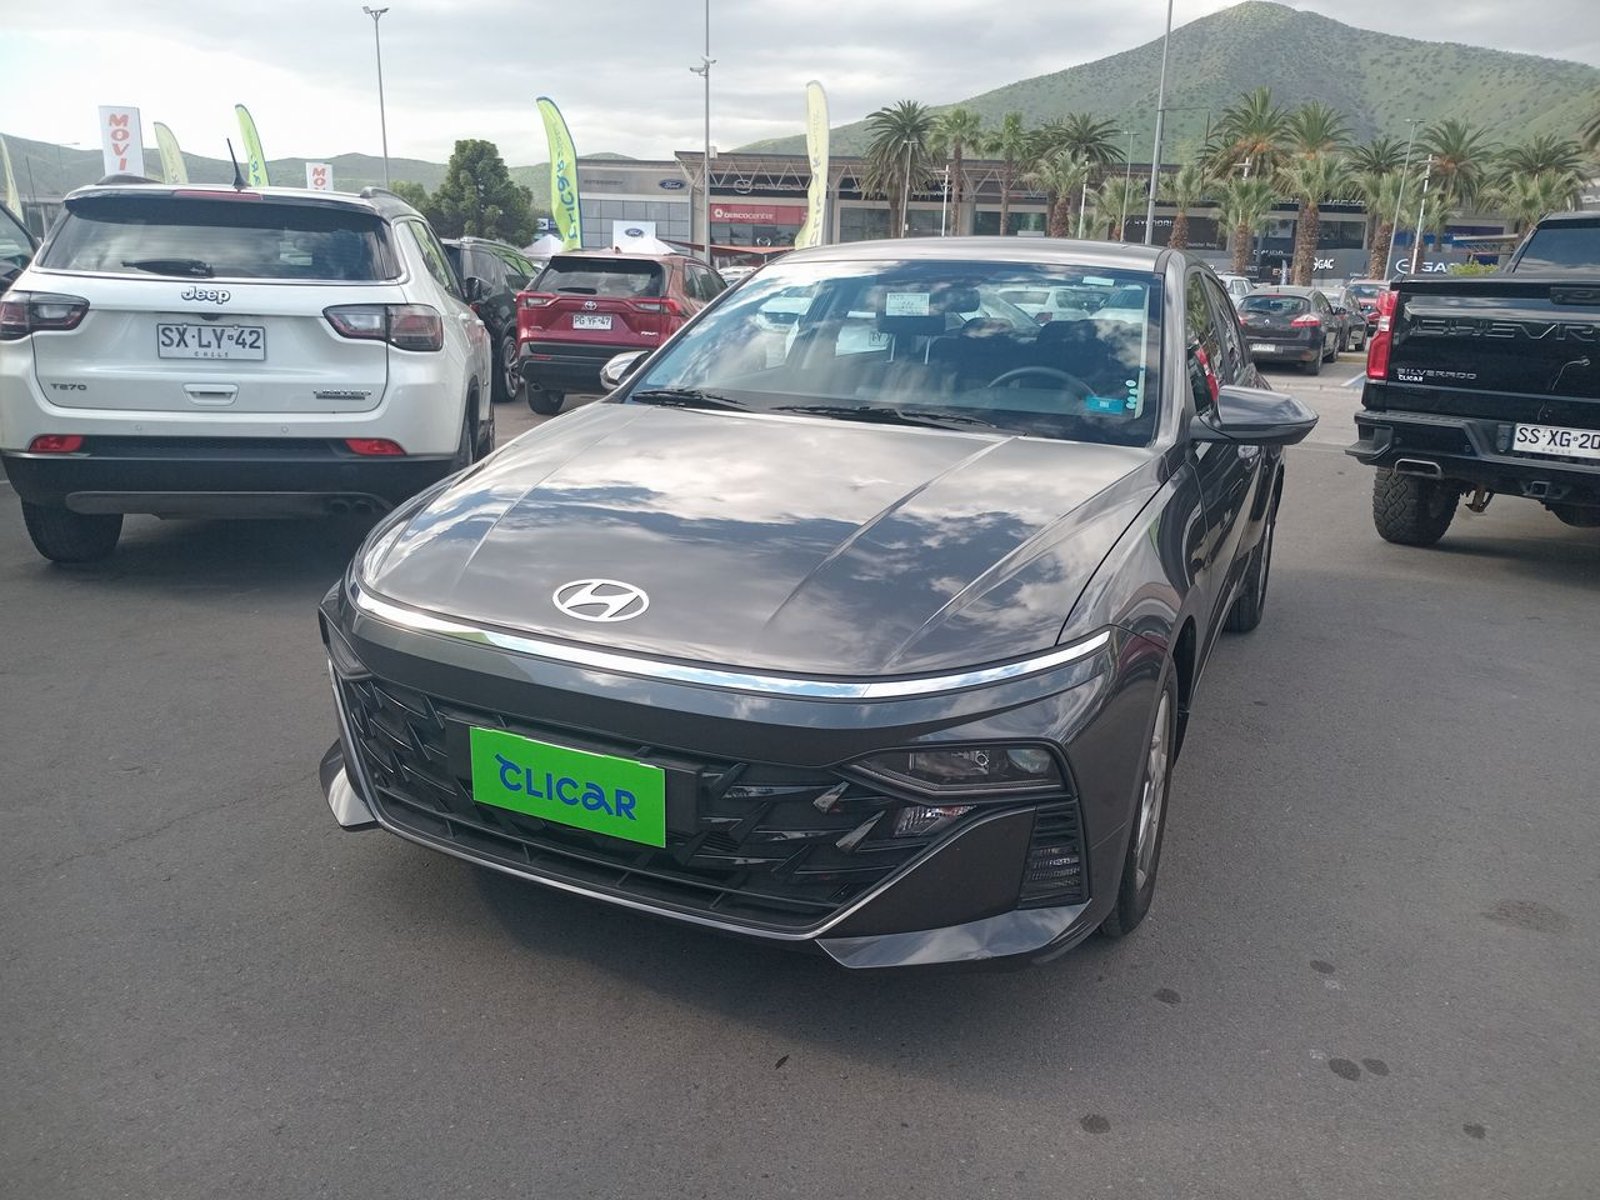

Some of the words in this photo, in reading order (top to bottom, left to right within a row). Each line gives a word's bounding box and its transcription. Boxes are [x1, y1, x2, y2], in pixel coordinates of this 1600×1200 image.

[109, 114, 129, 171] MOVI
[312, 167, 326, 190] MO
[1319, 259, 1334, 270] GAC
[1421, 261, 1458, 272] GA
[181, 286, 230, 304] Jeep
